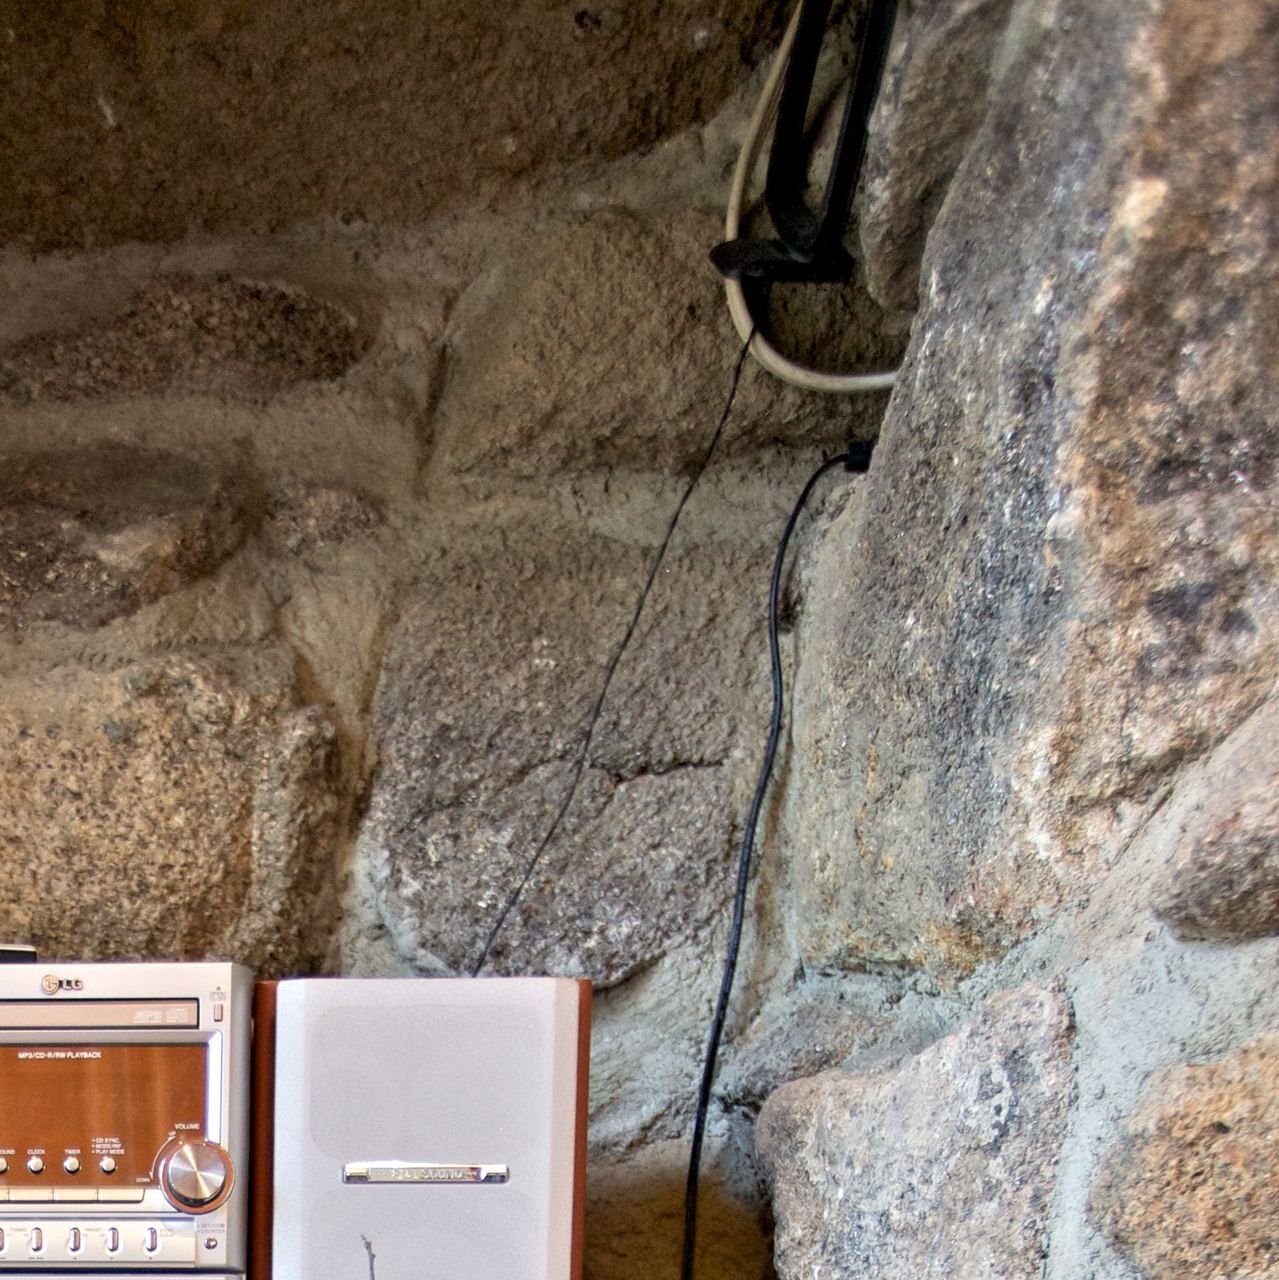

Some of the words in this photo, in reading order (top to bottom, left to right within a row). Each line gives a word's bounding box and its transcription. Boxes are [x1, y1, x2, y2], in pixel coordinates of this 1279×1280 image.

[62, 979, 83, 991] LG
[17, 1051, 66, 1060] MP3/CD-R/RW
[66, 1051, 102, 1059] PLAYBACK
[175, 1123, 200, 1131] VOLUME
